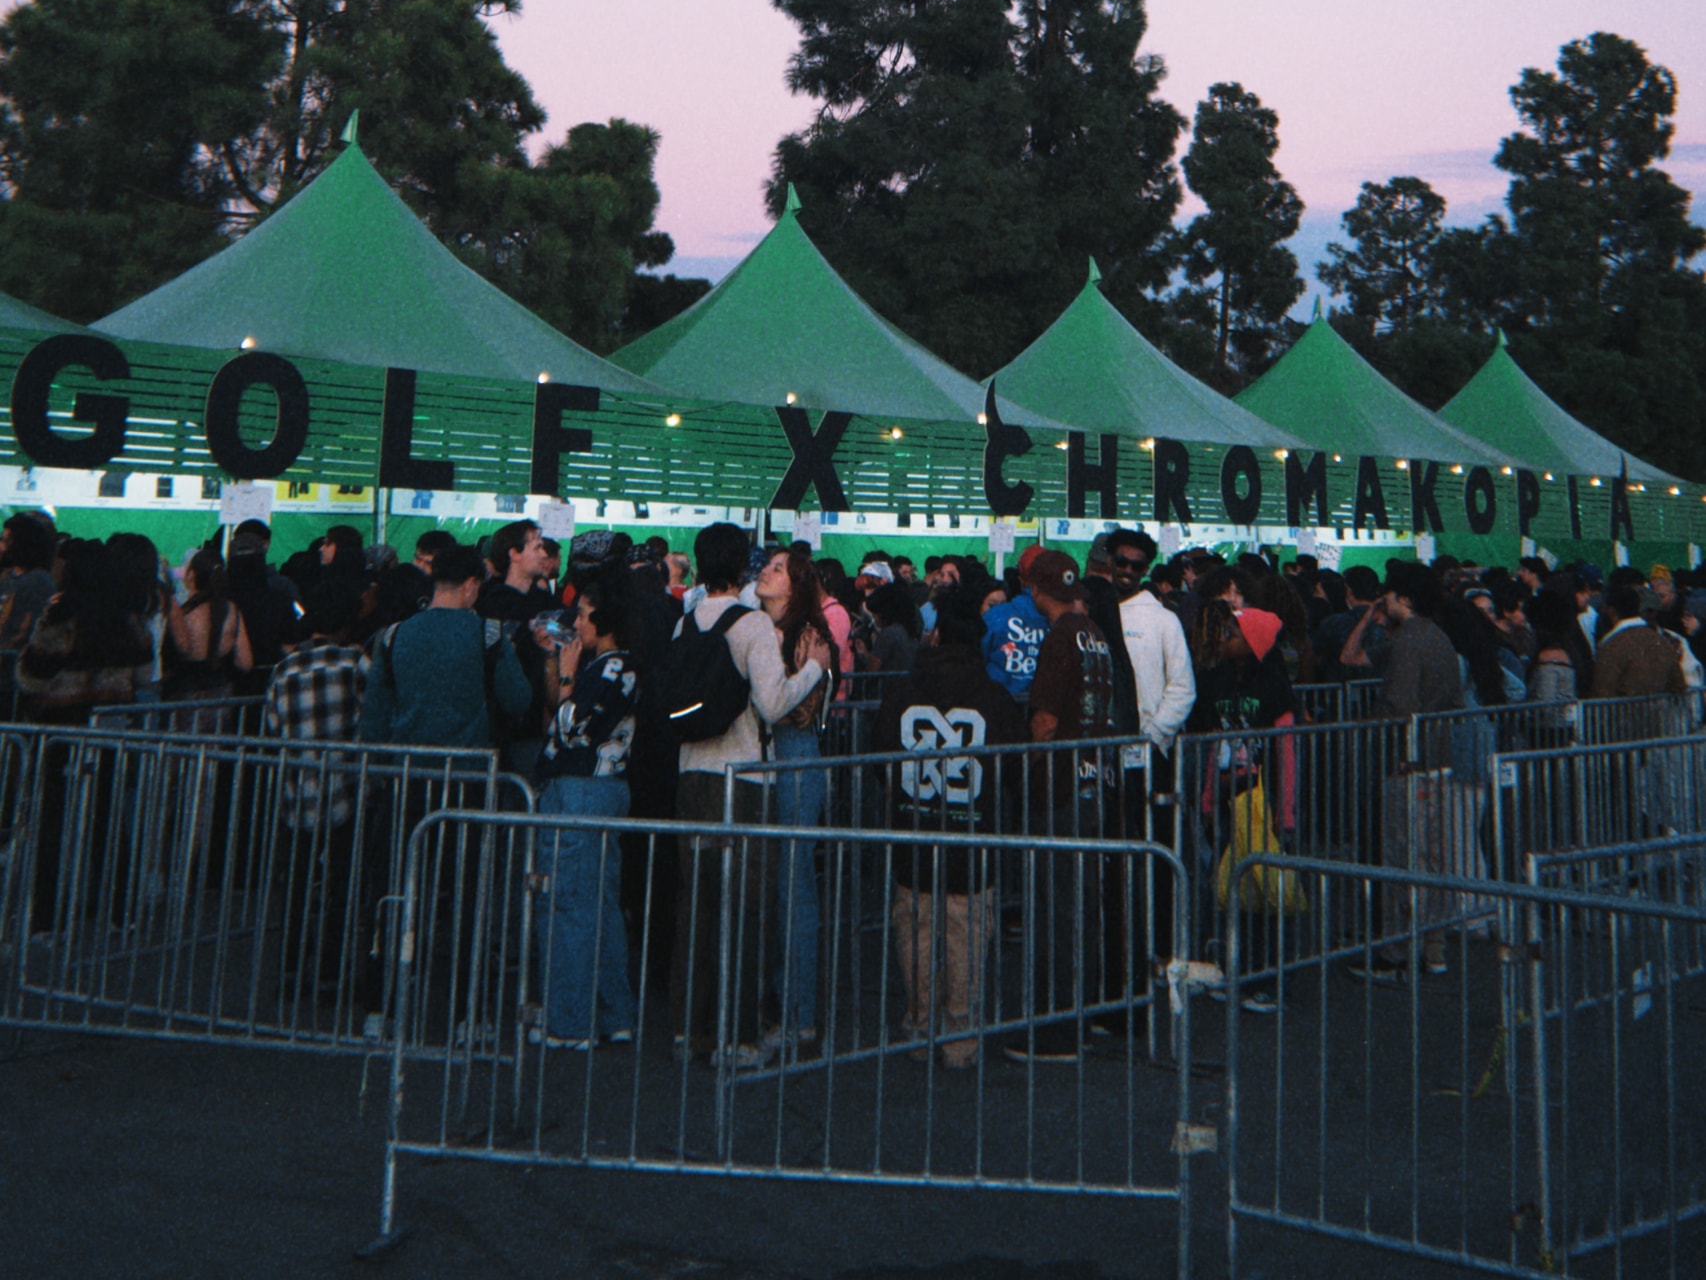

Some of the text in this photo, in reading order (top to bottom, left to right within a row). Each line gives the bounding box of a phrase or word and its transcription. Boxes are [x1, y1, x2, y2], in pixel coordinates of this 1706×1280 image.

[11, 333, 1634, 540] GOLF X CHROMAKOPIA
[1007, 616, 1047, 645] Sav
